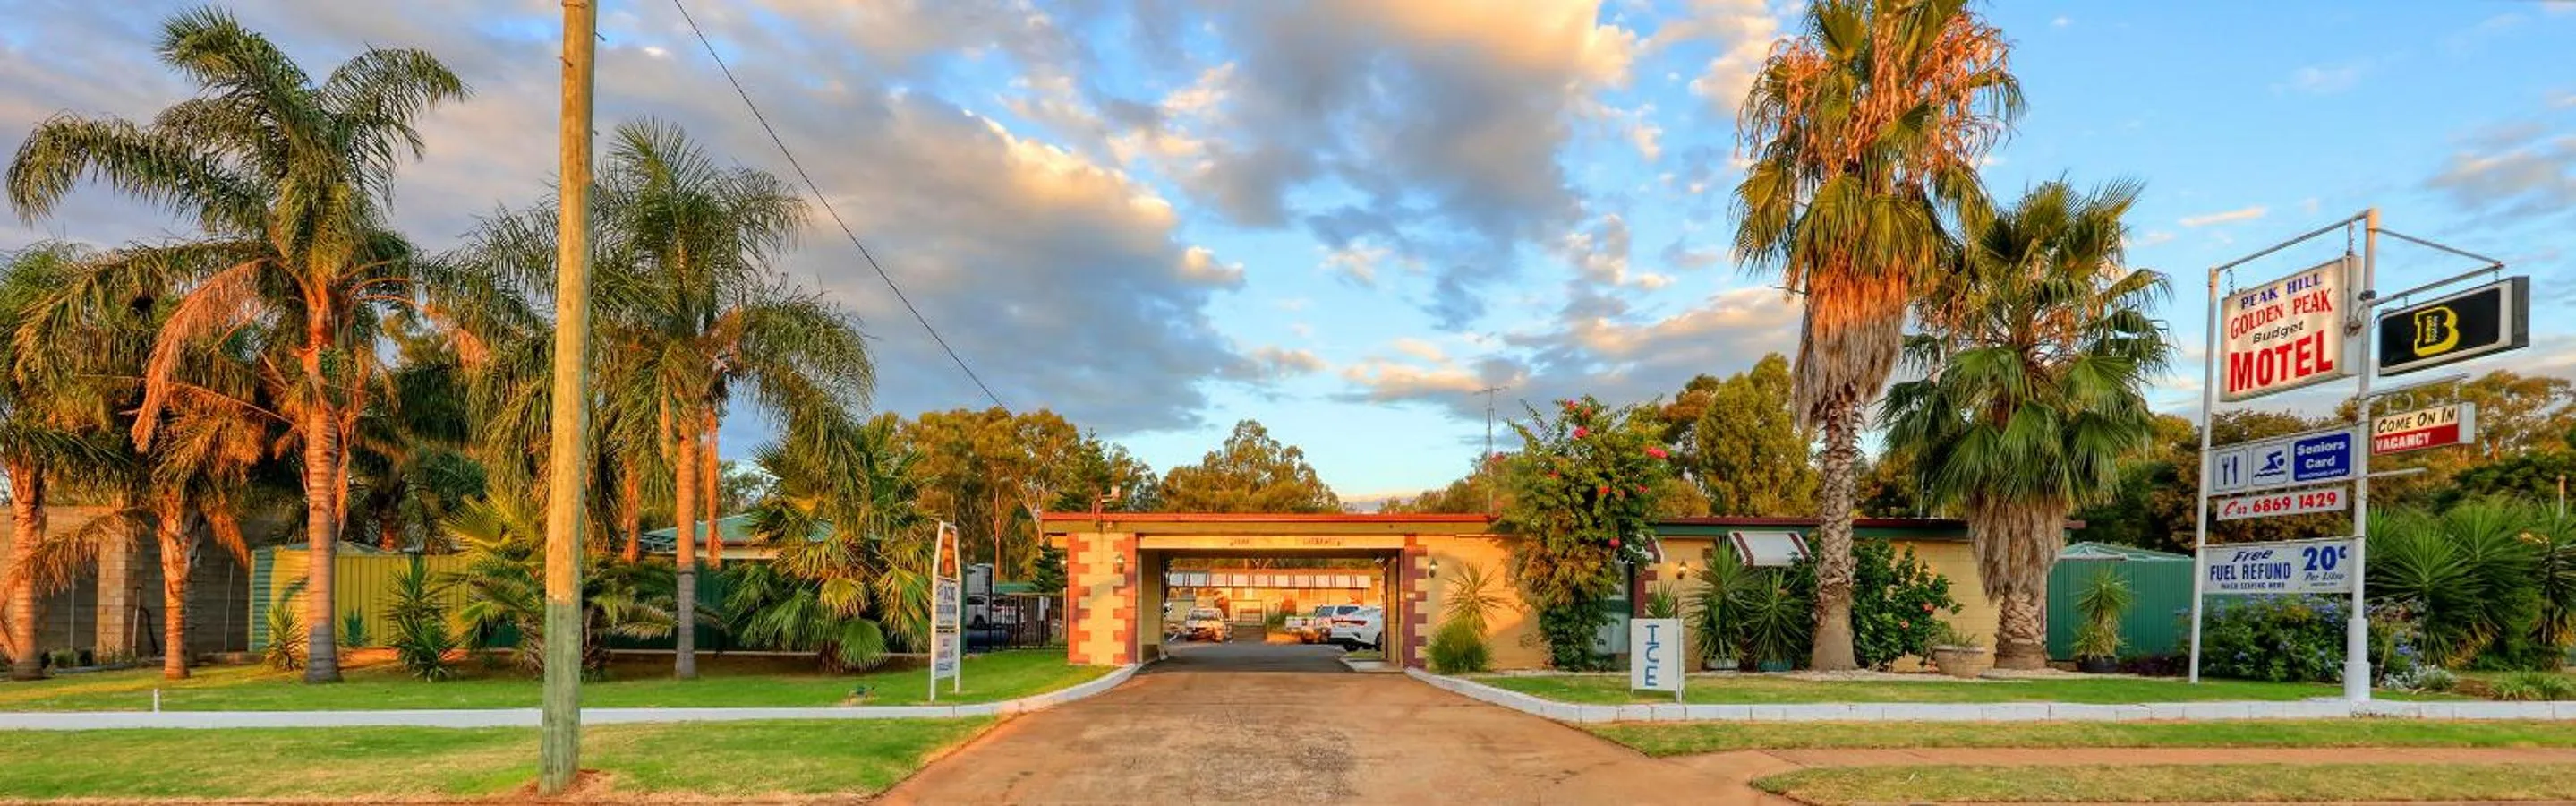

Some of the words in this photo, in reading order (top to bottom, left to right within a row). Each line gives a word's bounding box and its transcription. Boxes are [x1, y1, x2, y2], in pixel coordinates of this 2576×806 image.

[2241, 287, 2279, 309] PEAK
[2287, 273, 2322, 295] HILL
[2231, 304, 2284, 340] GOLDEN
[2292, 288, 2333, 315] PEAK
[2253, 320, 2304, 345] Budget
[2414, 306, 2460, 356] B
[2229, 330, 2333, 393] MOTEL
[2377, 416, 2412, 433] COME
[2418, 412, 2435, 426] ON
[2441, 407, 2455, 423] IN
[2297, 441, 2346, 456] Seniors
[2376, 432, 2431, 451] VACANCY
[2305, 455, 2336, 469] Card
[2252, 496, 2291, 513] 6869
[2298, 492, 2337, 509] 1429
[2232, 549, 2274, 562] Free
[2210, 564, 2237, 581] FUEL
[2242, 562, 2291, 580] REFUND
[1644, 624, 1660, 687] ICE
